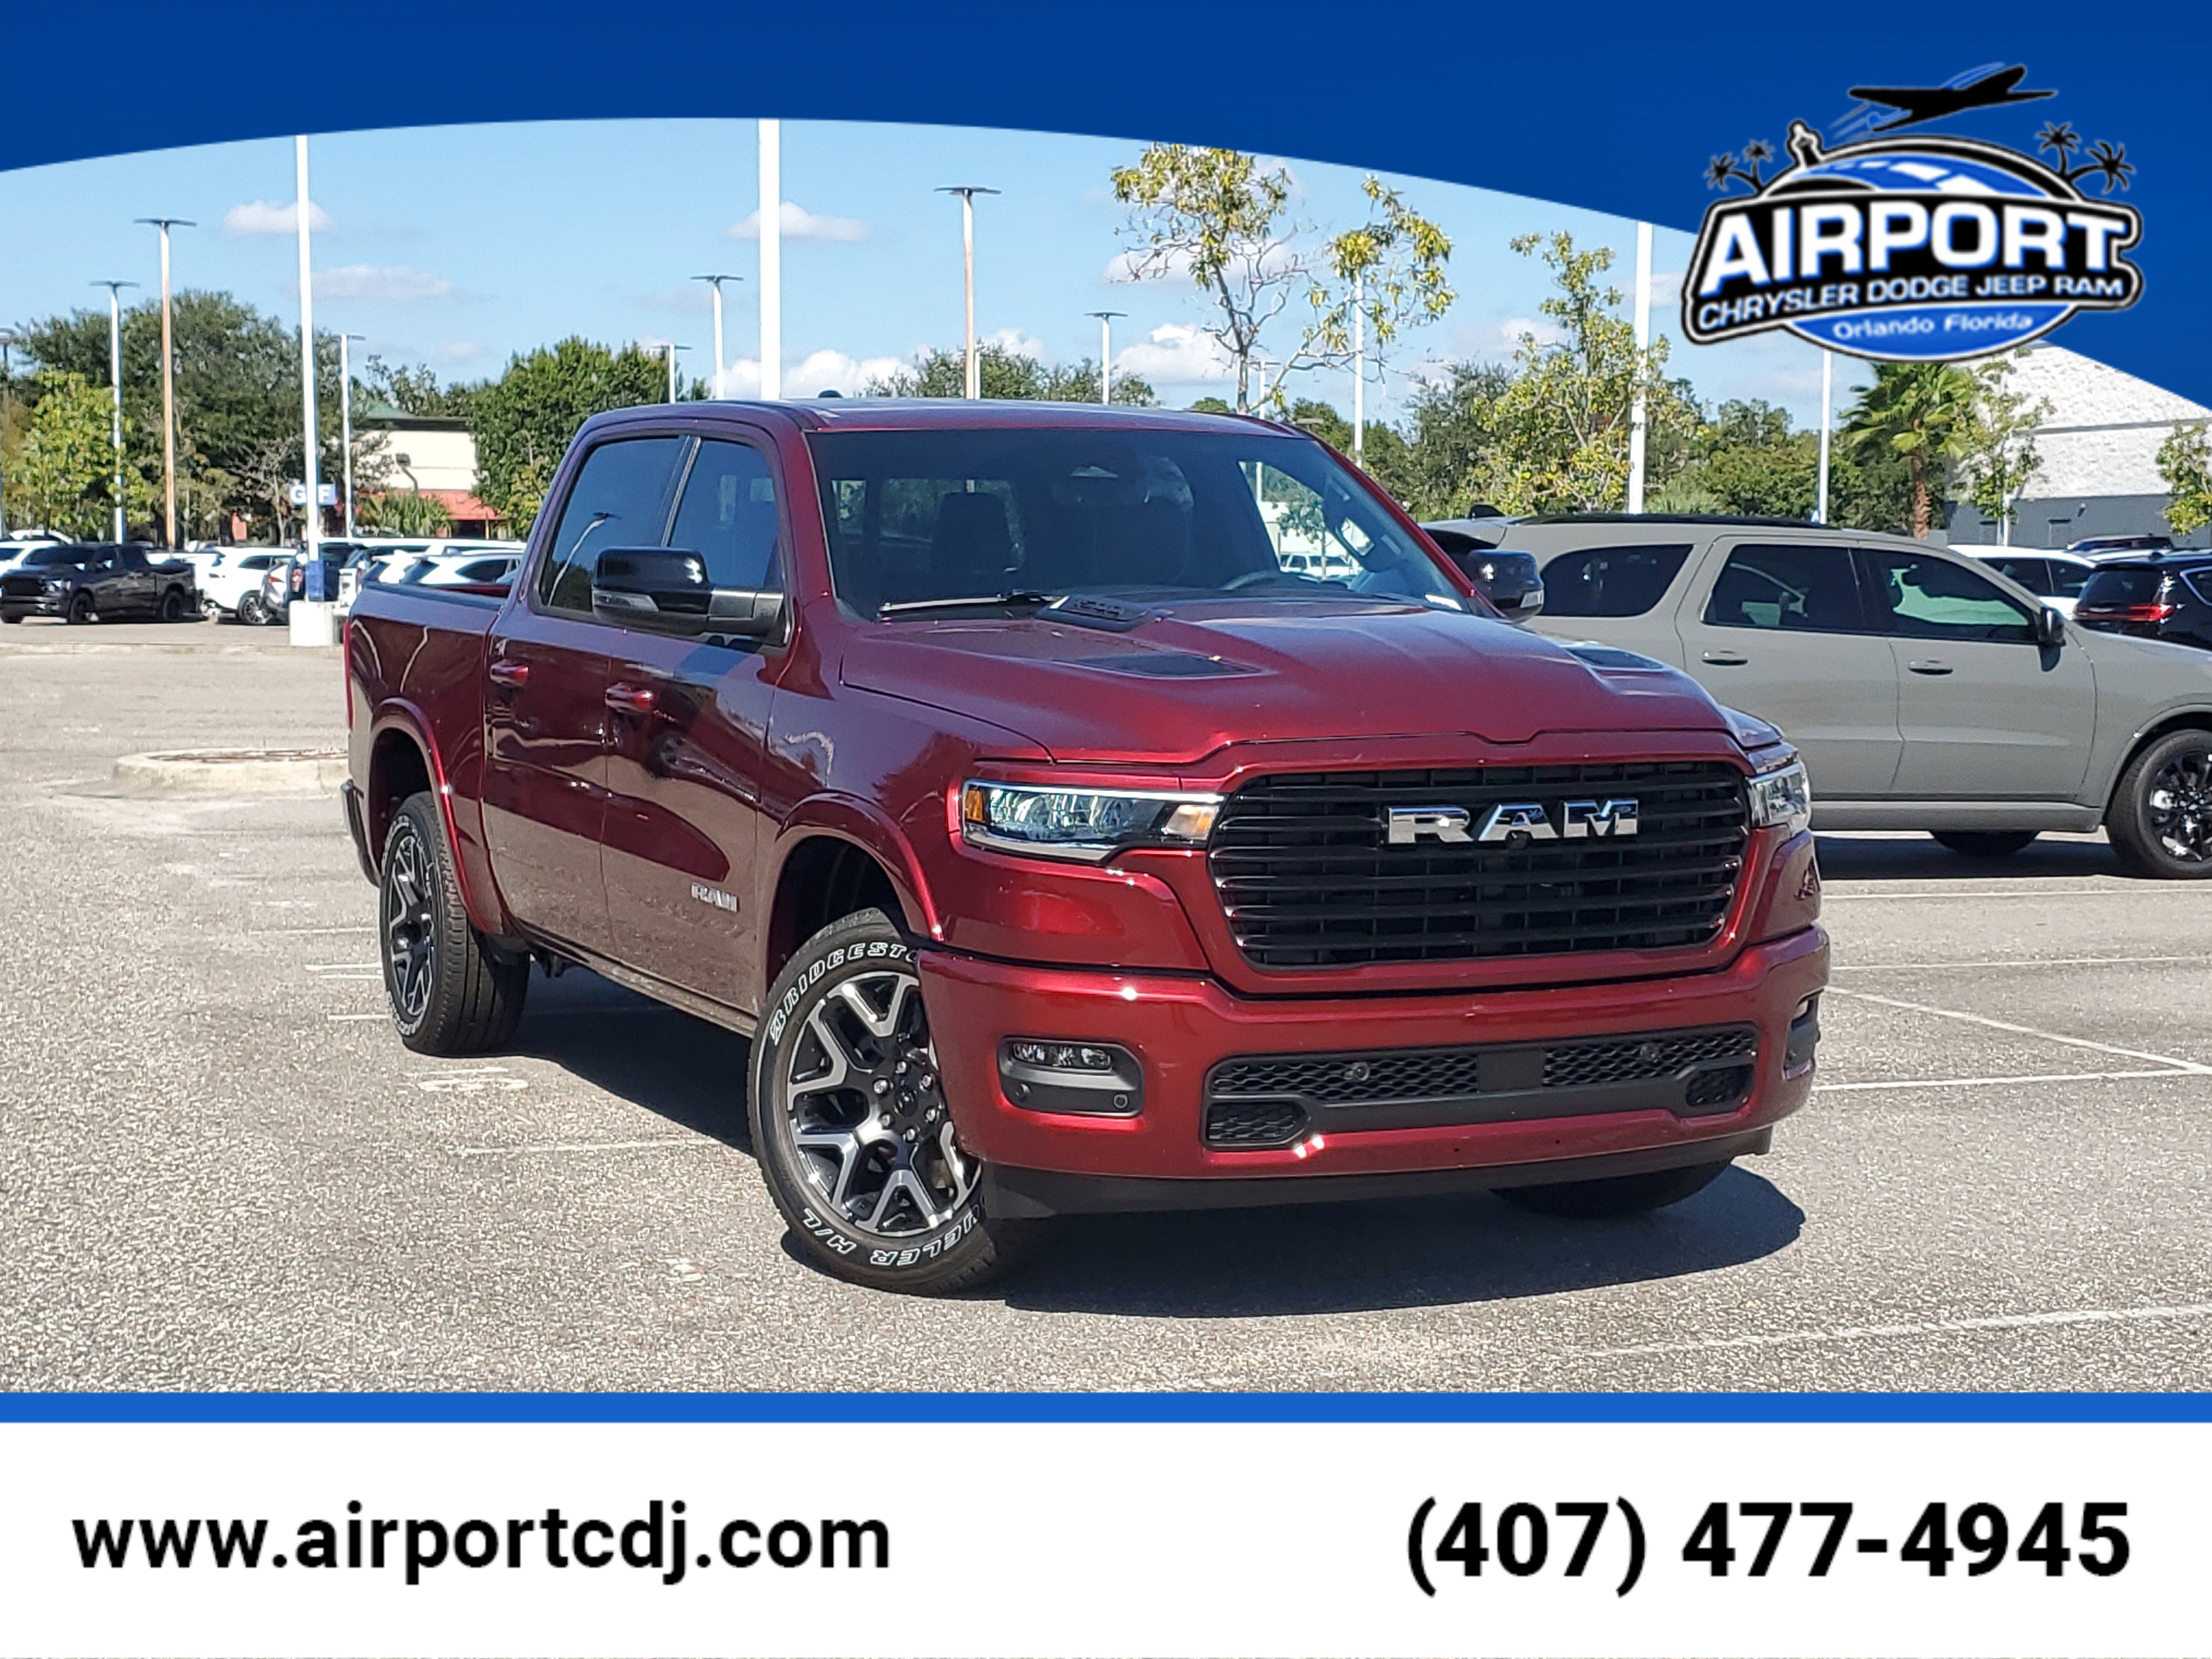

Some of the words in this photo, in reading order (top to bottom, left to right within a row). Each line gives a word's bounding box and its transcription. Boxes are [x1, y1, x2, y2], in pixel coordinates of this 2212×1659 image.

[1389, 799, 1638, 844] RAM
[691, 882, 737, 913] RAM
[870, 1194, 985, 1266] UELER
